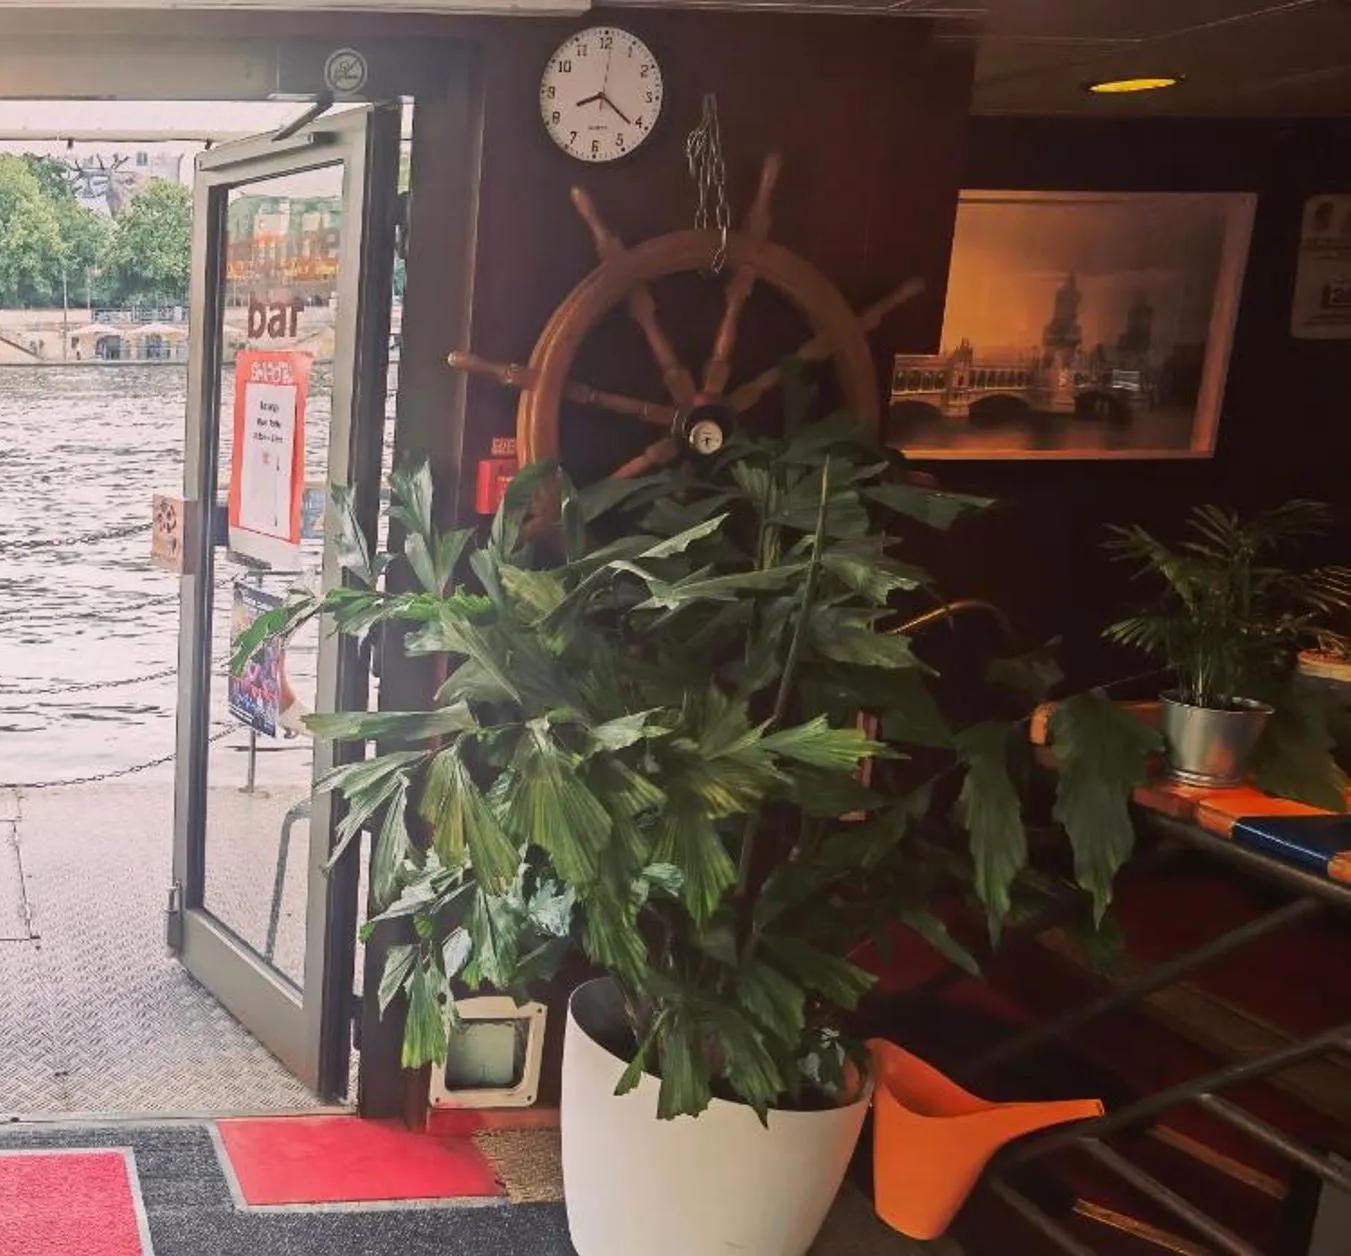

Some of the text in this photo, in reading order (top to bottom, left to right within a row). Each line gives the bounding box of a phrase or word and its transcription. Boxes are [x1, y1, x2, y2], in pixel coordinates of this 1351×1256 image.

[576, 43, 588, 57] 11
[599, 37, 613, 50] 12
[628, 45, 633, 58] 1
[558, 60, 572, 73] 10
[640, 64, 650, 78] 2
[547, 86, 556, 99] 9
[646, 91, 653, 103] 3
[552, 111, 561, 125] 8
[635, 116, 643, 129] 4
[570, 131, 578, 144] 7
[615, 133, 624, 147] 5
[591, 140, 600, 153] 6
[248, 290, 305, 339] bar
